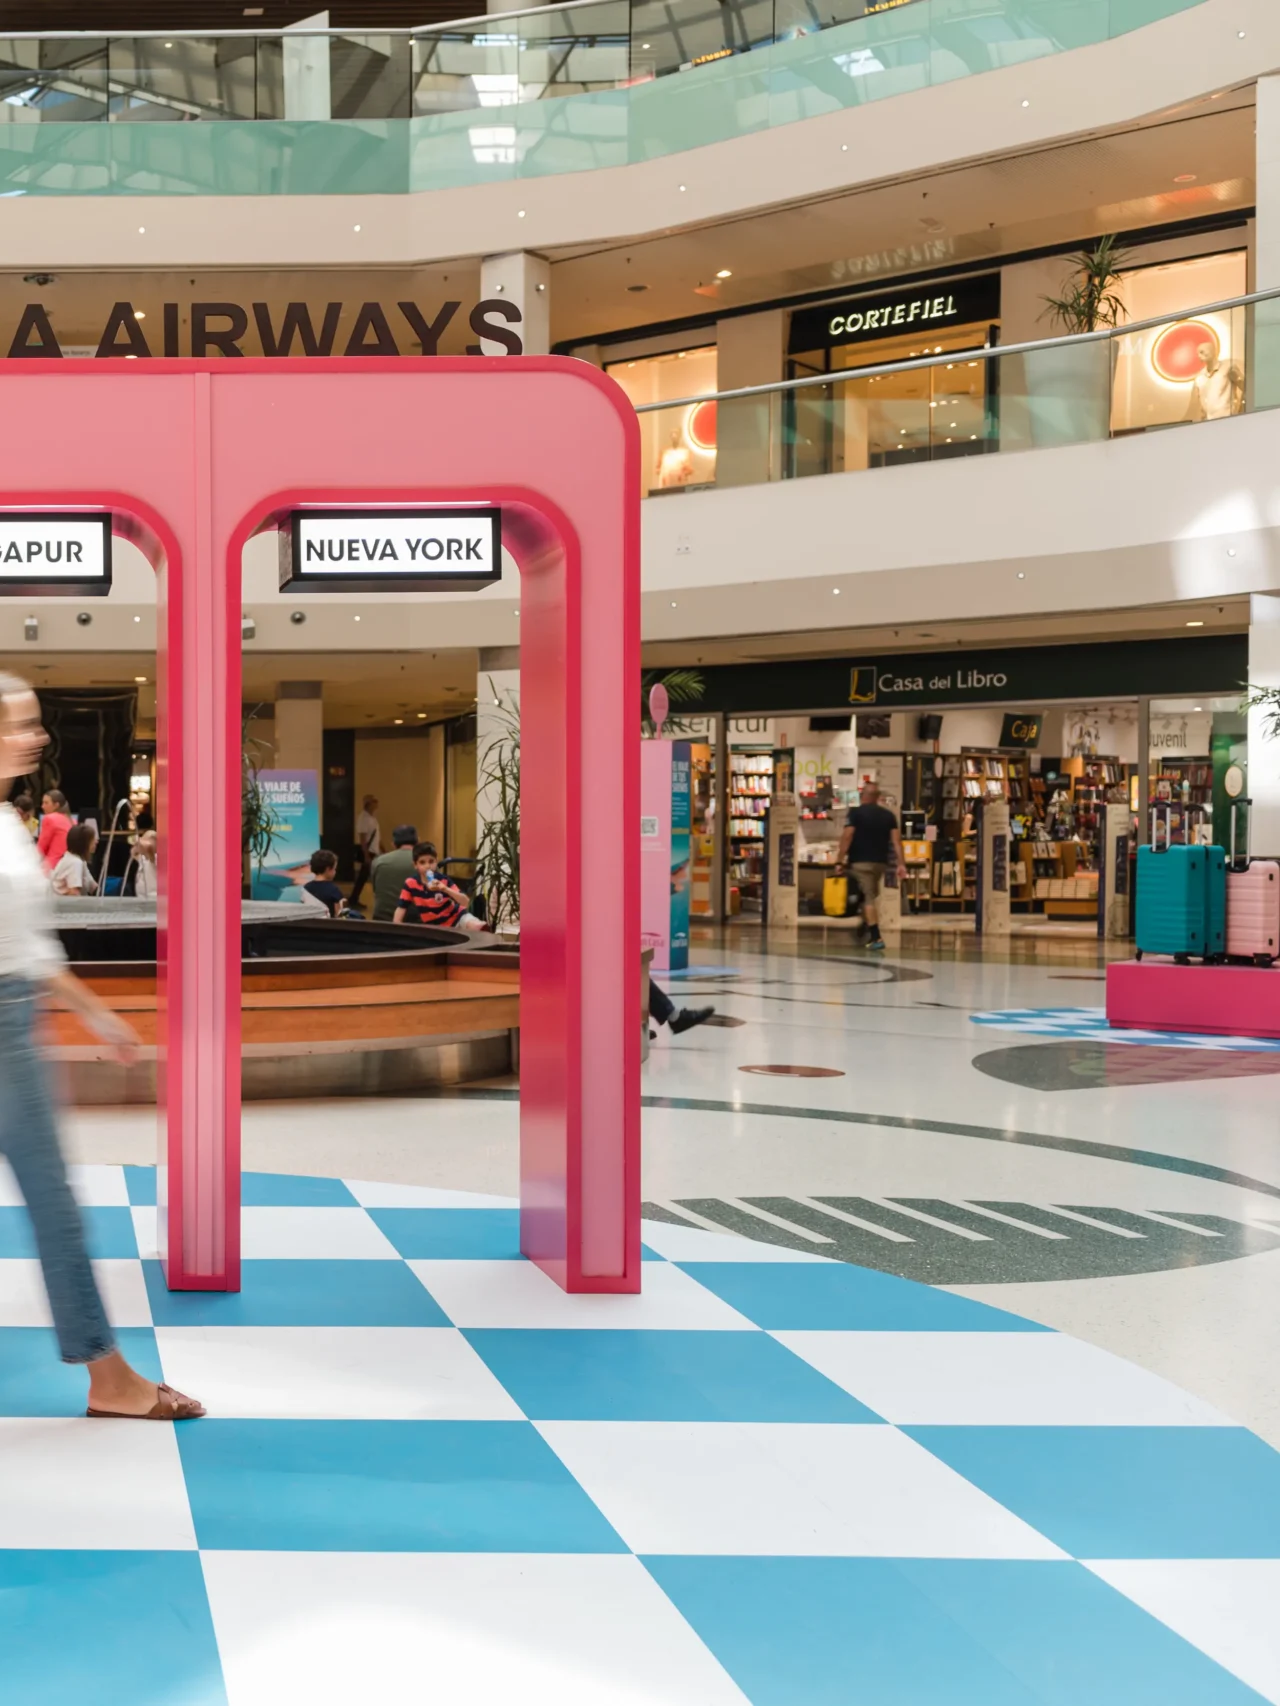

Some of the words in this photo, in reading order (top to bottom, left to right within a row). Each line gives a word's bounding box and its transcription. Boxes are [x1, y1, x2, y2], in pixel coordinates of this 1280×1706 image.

[828, 295, 957, 335] CORTEFIEL
[94, 299, 523, 358] AIRWAYS
[306, 539, 399, 561] NUEVA
[405, 538, 483, 560] YORK
[878, 674, 923, 692] Casa
[929, 676, 951, 689] del
[957, 670, 1007, 688] Libro
[1011, 720, 1038, 742] Caja
[264, 781, 288, 792] VIAJE
[290, 781, 301, 792] DE
[271, 791, 305, 804] SUEÑOS
